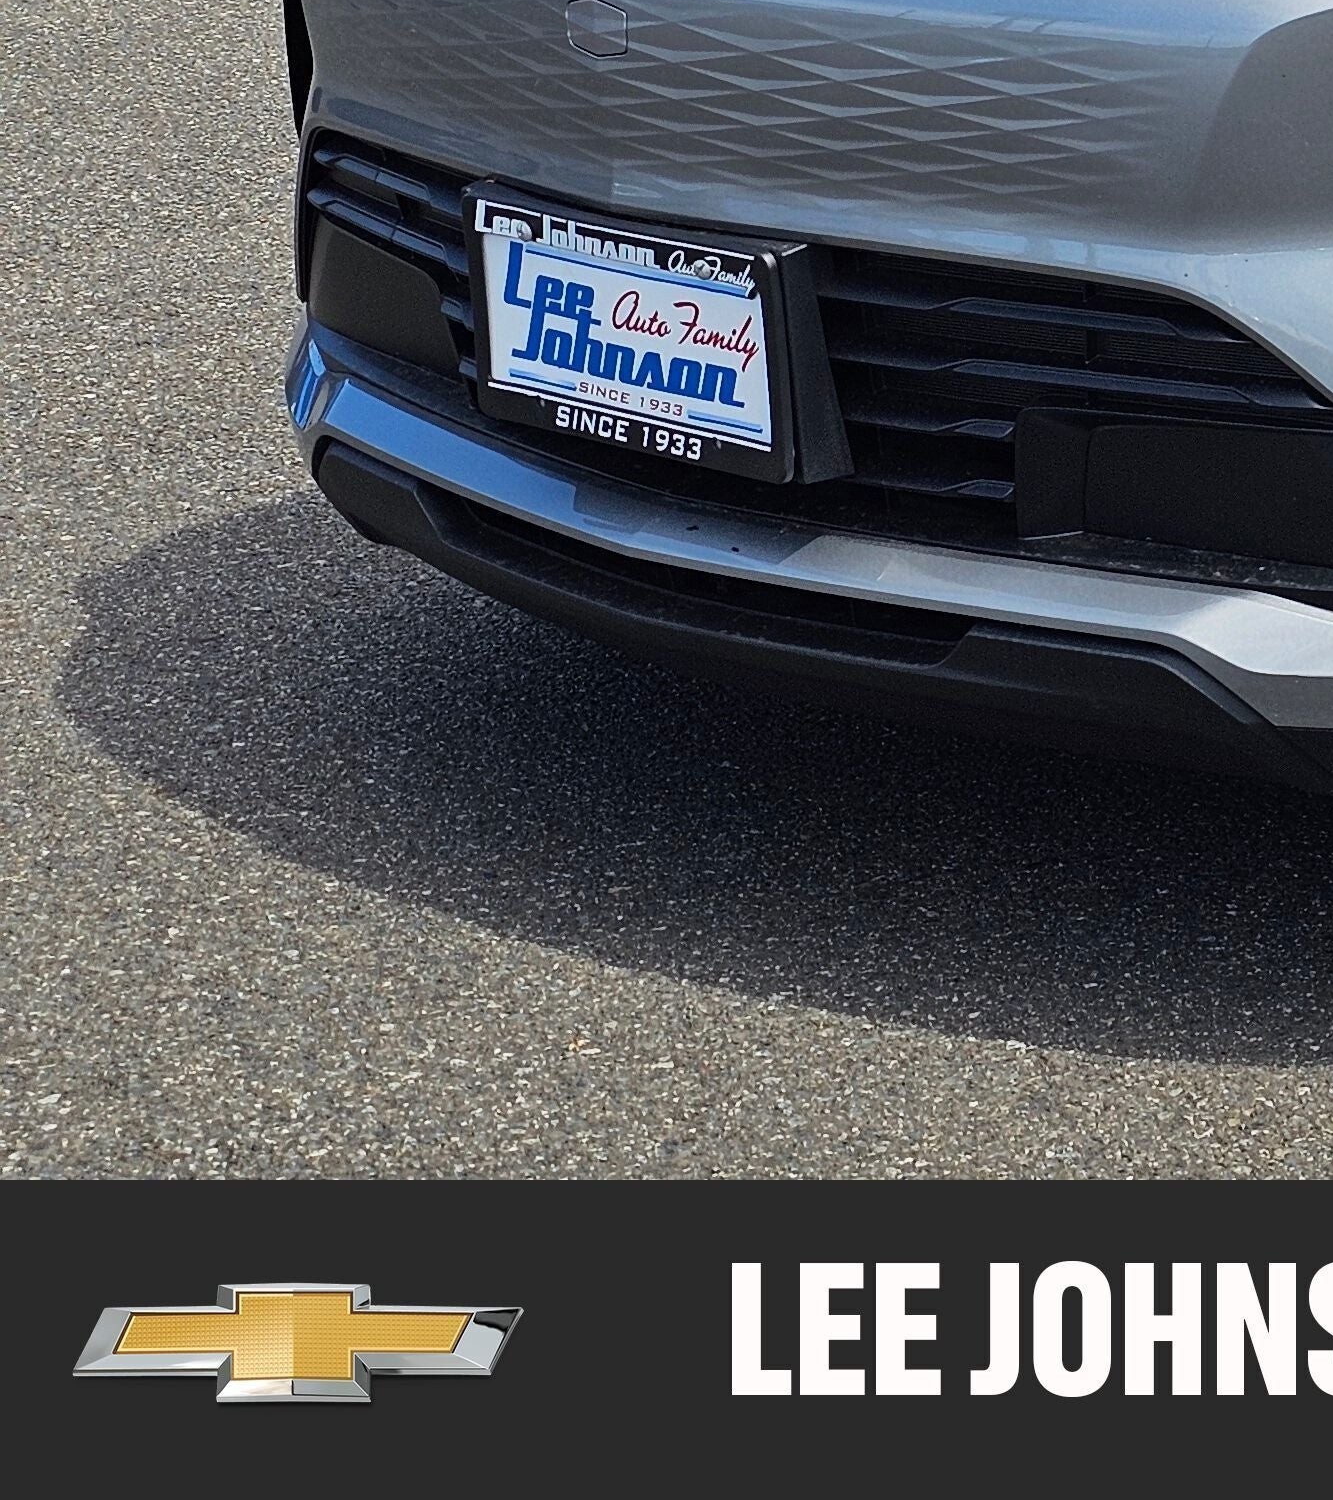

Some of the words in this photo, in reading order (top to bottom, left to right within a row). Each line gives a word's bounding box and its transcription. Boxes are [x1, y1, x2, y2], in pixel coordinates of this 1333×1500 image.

[535, 214, 660, 269] Johnson
[503, 241, 601, 325] Lee
[611, 290, 672, 338] Auto
[673, 301, 760, 372] Family
[511, 304, 746, 408] Johnson
[578, 380, 631, 405] SINCE
[638, 395, 684, 417] 1933
[555, 405, 631, 444] SINCE
[640, 426, 703, 461] 1933
